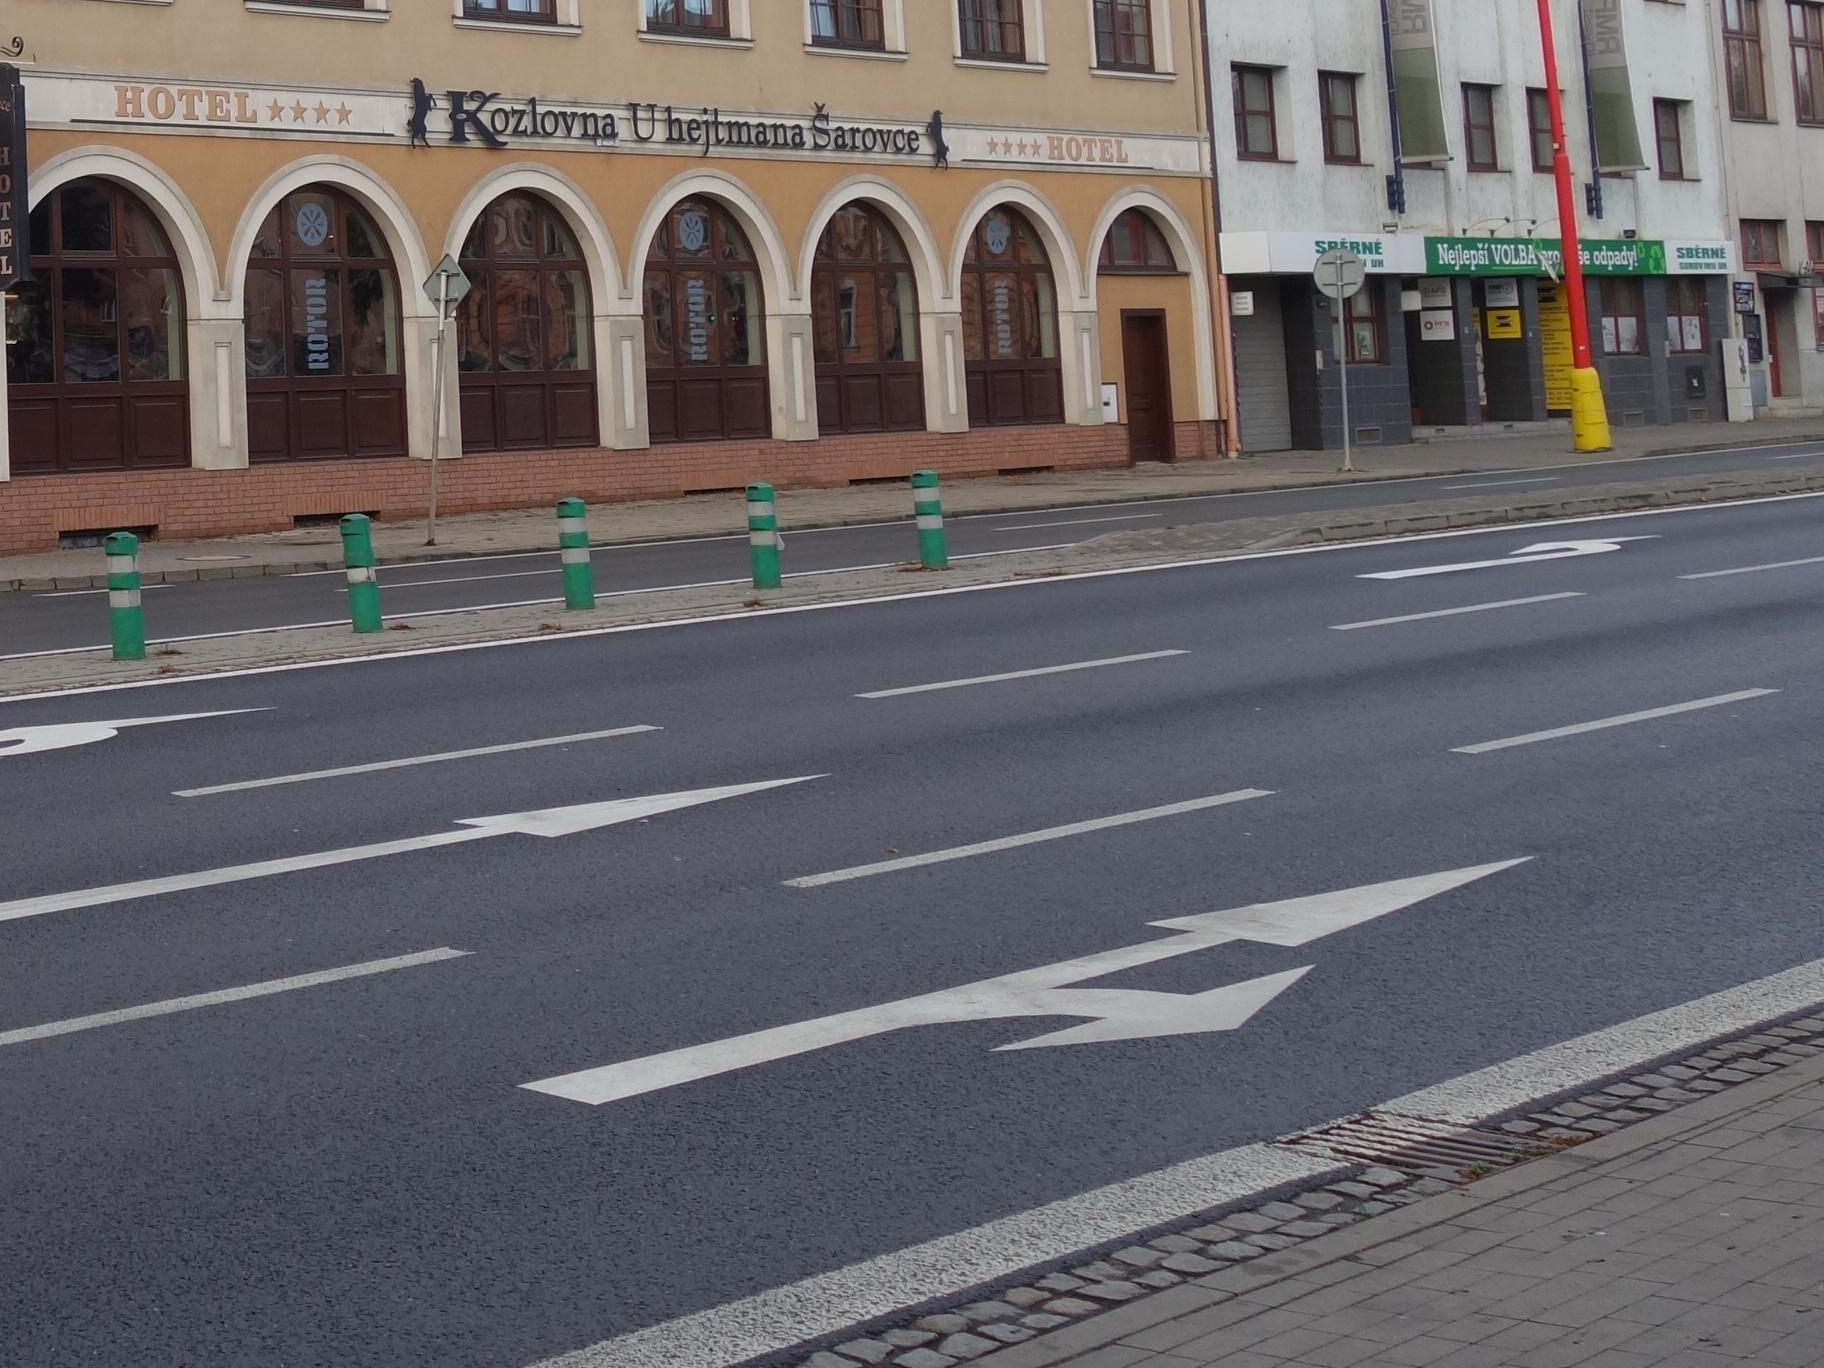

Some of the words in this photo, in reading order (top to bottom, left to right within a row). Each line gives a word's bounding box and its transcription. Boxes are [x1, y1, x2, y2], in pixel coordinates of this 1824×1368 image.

[114, 85, 258, 124] HOTEL
[446, 90, 619, 147] Kozlovna
[628, 102, 658, 141] U
[665, 106, 806, 157] hejtmana
[812, 102, 920, 153] Šarovce
[1047, 135, 1128, 163] HOTEL
[1371, 259, 1384, 268] UH
[1437, 242, 1490, 271] Nejlepší
[1490, 244, 1538, 265] VOLBA
[1577, 244, 1591, 265] še
[1593, 245, 1639, 271] odpady!
[1676, 244, 1727, 259] SBĚRNÉ
[305, 278, 329, 370] ROTOR
[687, 279, 708, 361] ROTOR
